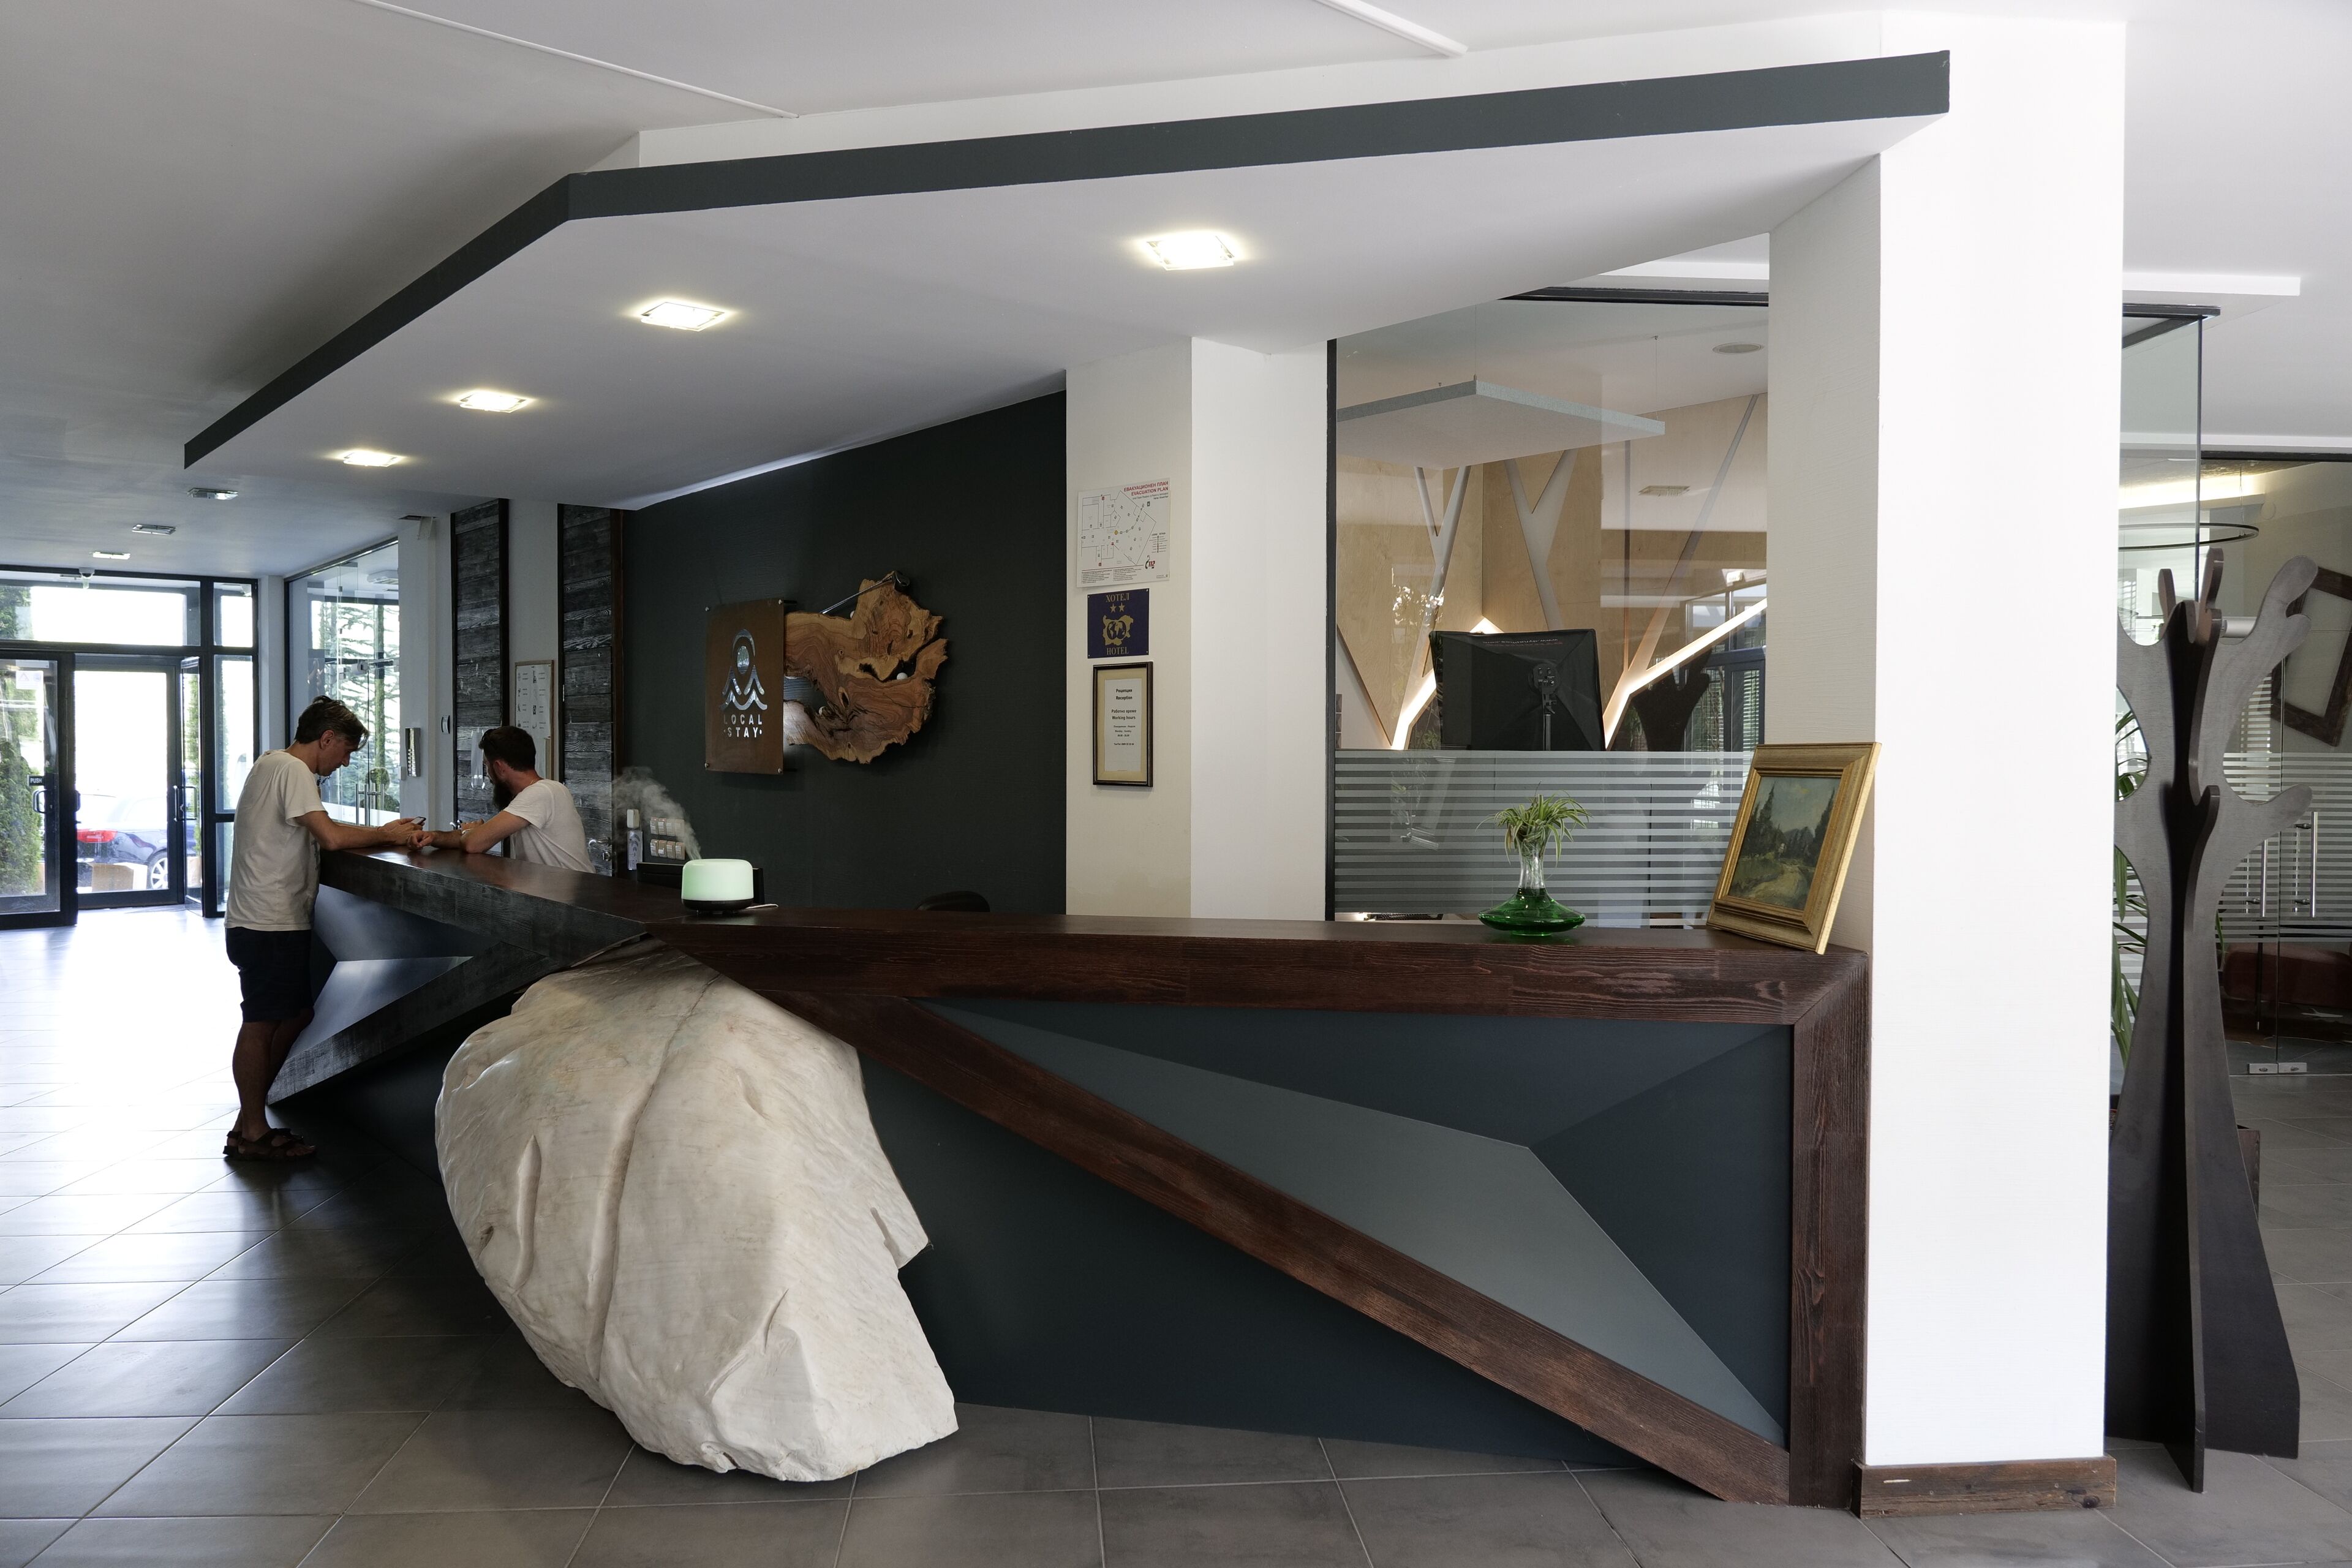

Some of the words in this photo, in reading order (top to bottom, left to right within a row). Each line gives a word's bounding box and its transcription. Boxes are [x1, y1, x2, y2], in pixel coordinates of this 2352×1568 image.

[1123, 483, 1156, 492] ЕВАКУАЦИОНЕН
[1106, 592, 1129, 603] ХОТЕЛ
[1106, 646, 1129, 655] HOTEL
[723, 714, 763, 725] LOCAL
